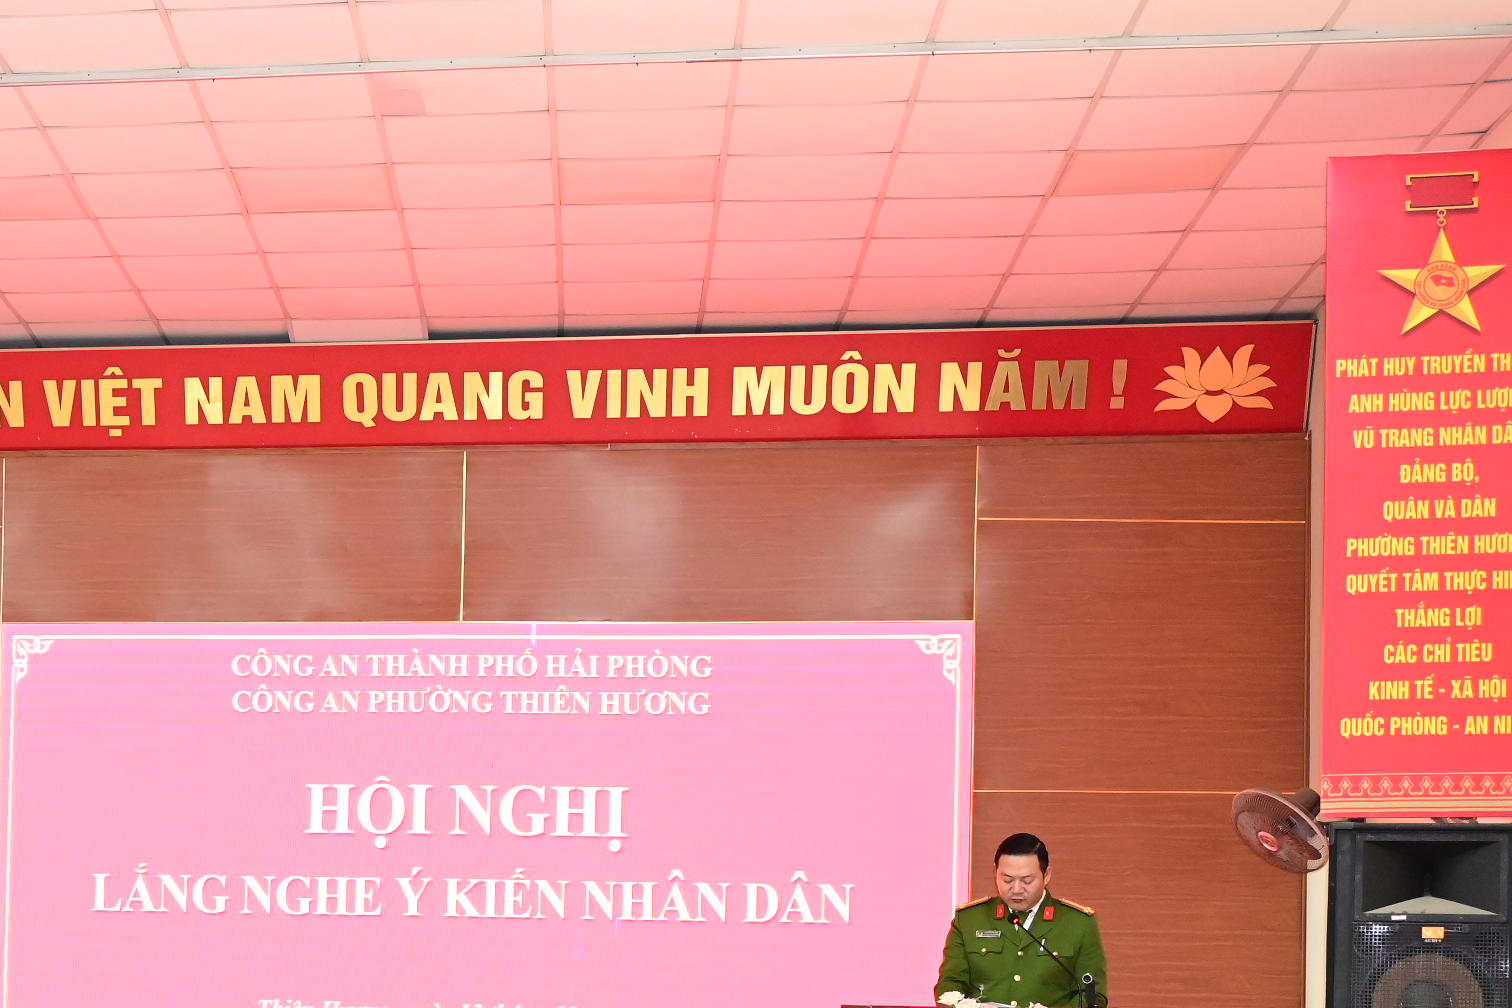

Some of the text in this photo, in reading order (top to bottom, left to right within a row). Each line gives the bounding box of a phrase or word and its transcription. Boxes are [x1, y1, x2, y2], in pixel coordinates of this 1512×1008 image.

[1336, 355, 1379, 377] PHÁT
[1384, 357, 1416, 376] HUY
[43, 367, 162, 436] VIỆT
[184, 375, 321, 425] NAM
[343, 370, 543, 427] QUANG
[566, 368, 709, 418] VINH
[732, 351, 916, 416] MUÔN
[939, 349, 1088, 412] NĂM
[1110, 360, 1127, 408] !
[1349, 394, 1384, 413] ANH
[1389, 389, 1435, 411] HÙNG
[1441, 389, 1472, 413] LỰC
[1354, 426, 1375, 448] VŨ
[1380, 428, 1434, 448] TRANG
[1440, 423, 1487, 445] NHÂN
[1400, 458, 1479, 485] ĐẢNG BỘ,
[1384, 495, 1496, 522] QUÂN VÀ DÂN
[1347, 534, 1415, 557] PHƯỜNG
[1420, 532, 1469, 555] THIÊN
[1347, 568, 1397, 595] QUYẾT
[1403, 569, 1439, 591] TÂM
[1444, 570, 1487, 593] THỰC
[1395, 602, 1481, 630] THẮNG LỢI
[231, 648, 712, 677] CÔNG AN THÀNH PHỐ HẢI PHÒNG
[1384, 638, 1492, 663] CÁC CHỈ TIÊU
[232, 684, 711, 714] CÔNG AN PHƯỜNG THIÊN HƯƠNG
[1370, 681, 1409, 700] KINH
[1415, 674, 1434, 699] TẾ
[1451, 676, 1474, 698] XÃ
[1479, 675, 1507, 701] HỘI
[1341, 711, 1384, 738] QUỐC
[1391, 712, 1448, 736] PHÒNG
[1465, 716, 1488, 734] AN
[304, 776, 629, 852] HỘI NGHỊ
[91, 863, 854, 923] LẮNG NGHE Ý KIẾN NHÂN DÂN
